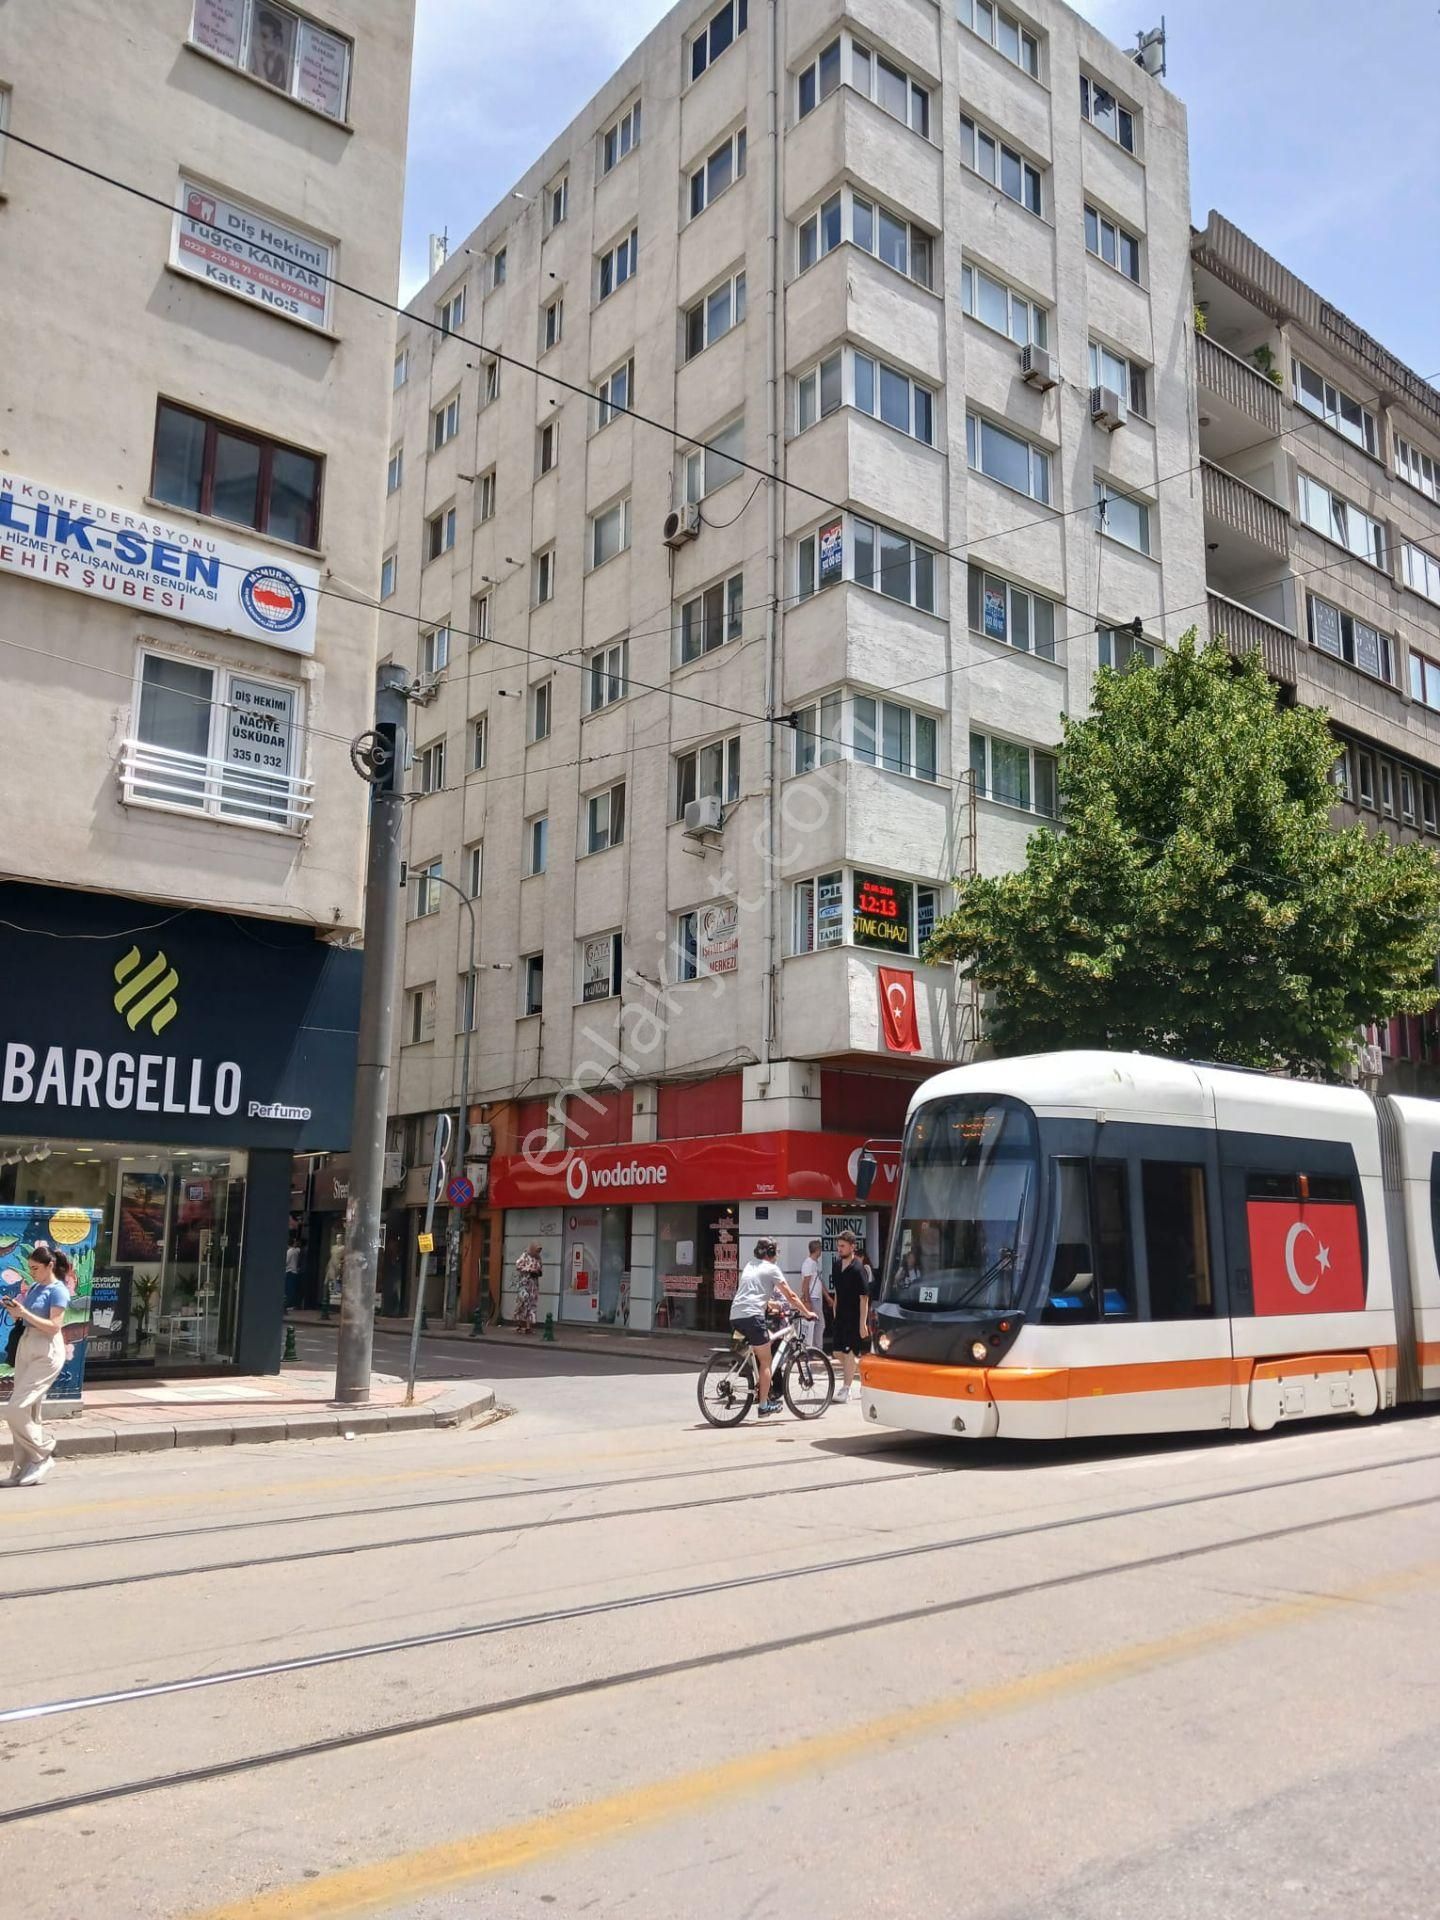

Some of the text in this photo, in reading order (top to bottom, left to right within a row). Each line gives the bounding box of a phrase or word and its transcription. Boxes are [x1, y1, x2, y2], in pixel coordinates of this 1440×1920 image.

[188, 219, 318, 287] Tuğçe KANTAR
[228, 214, 320, 266] Diş Hekimi
[211, 252, 228, 264] 220
[206, 264, 299, 313] Kat: 3 No:5
[22, 484, 215, 553] KONFEDERASYONU
[0, 491, 220, 589] LIK-SEN
[7, 531, 218, 601] HİZMET ÇALIŞANLARI SENDİKASI
[82, 569, 185, 610] ŞUBESİ
[235, 690, 286, 711] DİŞ HEKİMİ
[232, 725, 286, 748] ÜSKÜDAR
[232, 748, 282, 768] 335 0 332
[859, 894, 897, 917] 12:13
[878, 921, 908, 943] CİHAZI
[2, 1043, 242, 1116] BARGELLO
[249, 1102, 311, 1120] Perfume
[592, 1161, 667, 1187] vodafone
[924, 1291, 933, 1301] 29
